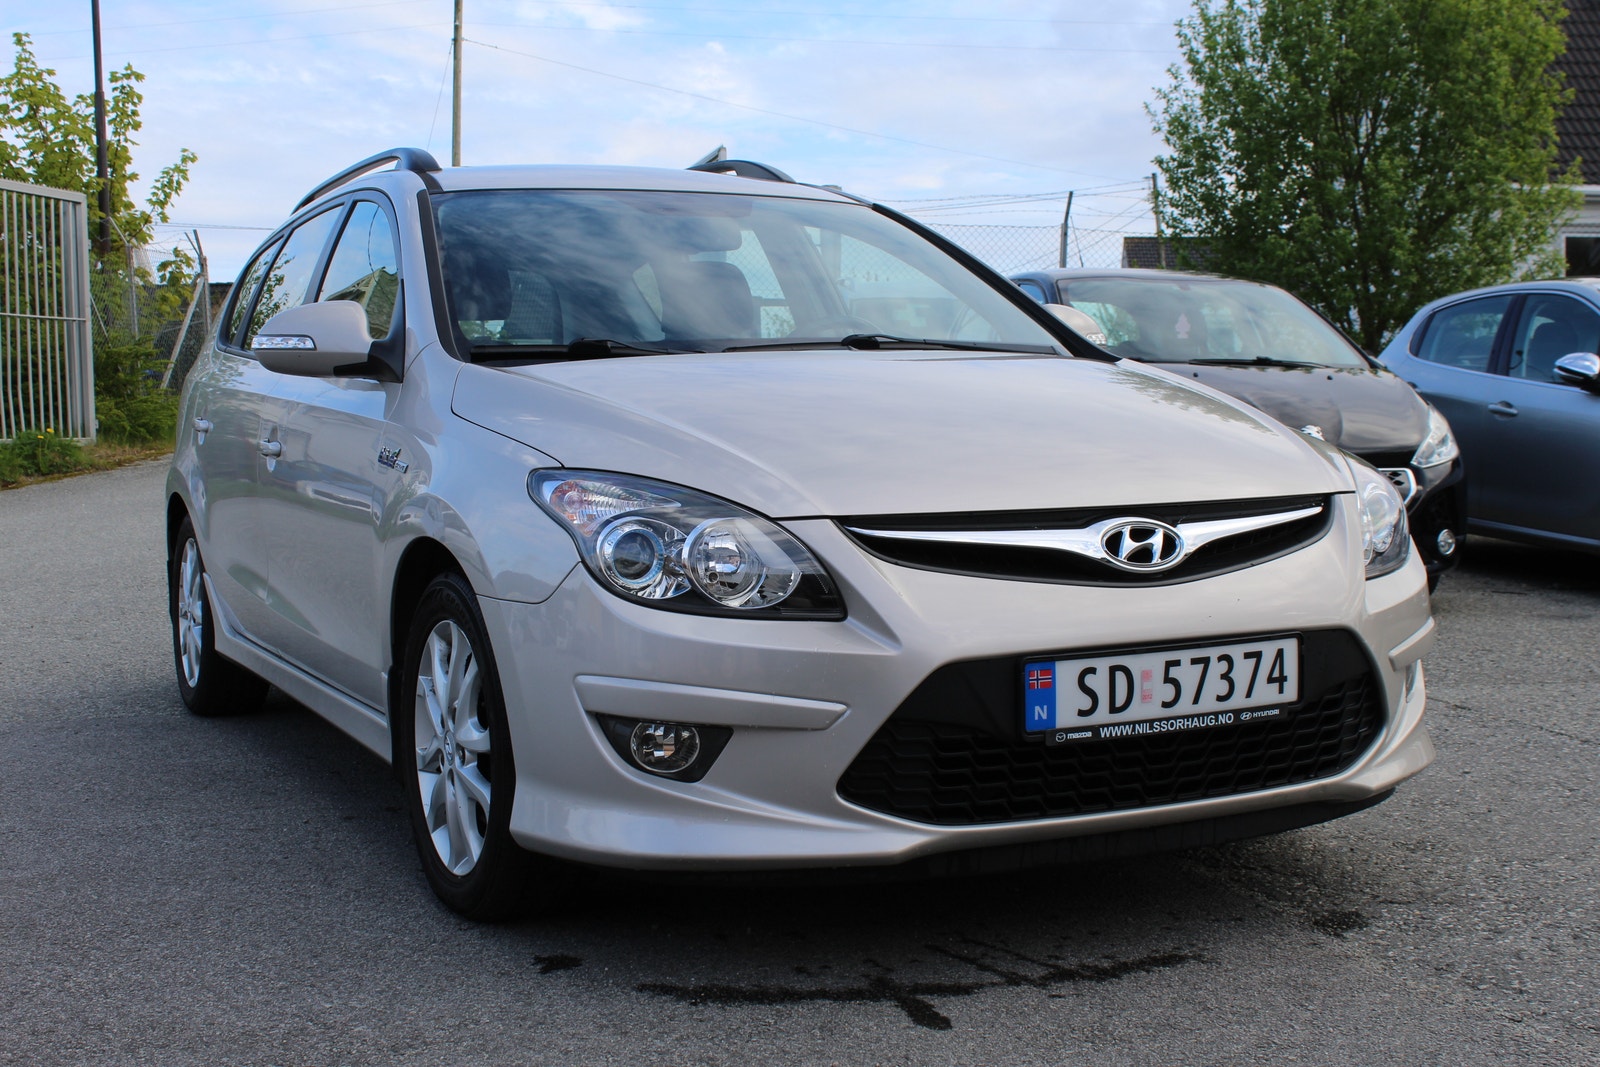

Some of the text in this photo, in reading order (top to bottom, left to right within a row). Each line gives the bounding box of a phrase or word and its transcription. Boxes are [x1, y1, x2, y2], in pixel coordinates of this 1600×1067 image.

[1077, 648, 1288, 717] SD 57374
[1034, 705, 1048, 720] N
[1100, 713, 1234, 738] WWW.NILSSORHAUG.NO
[1253, 709, 1280, 718] HYUNDAI
